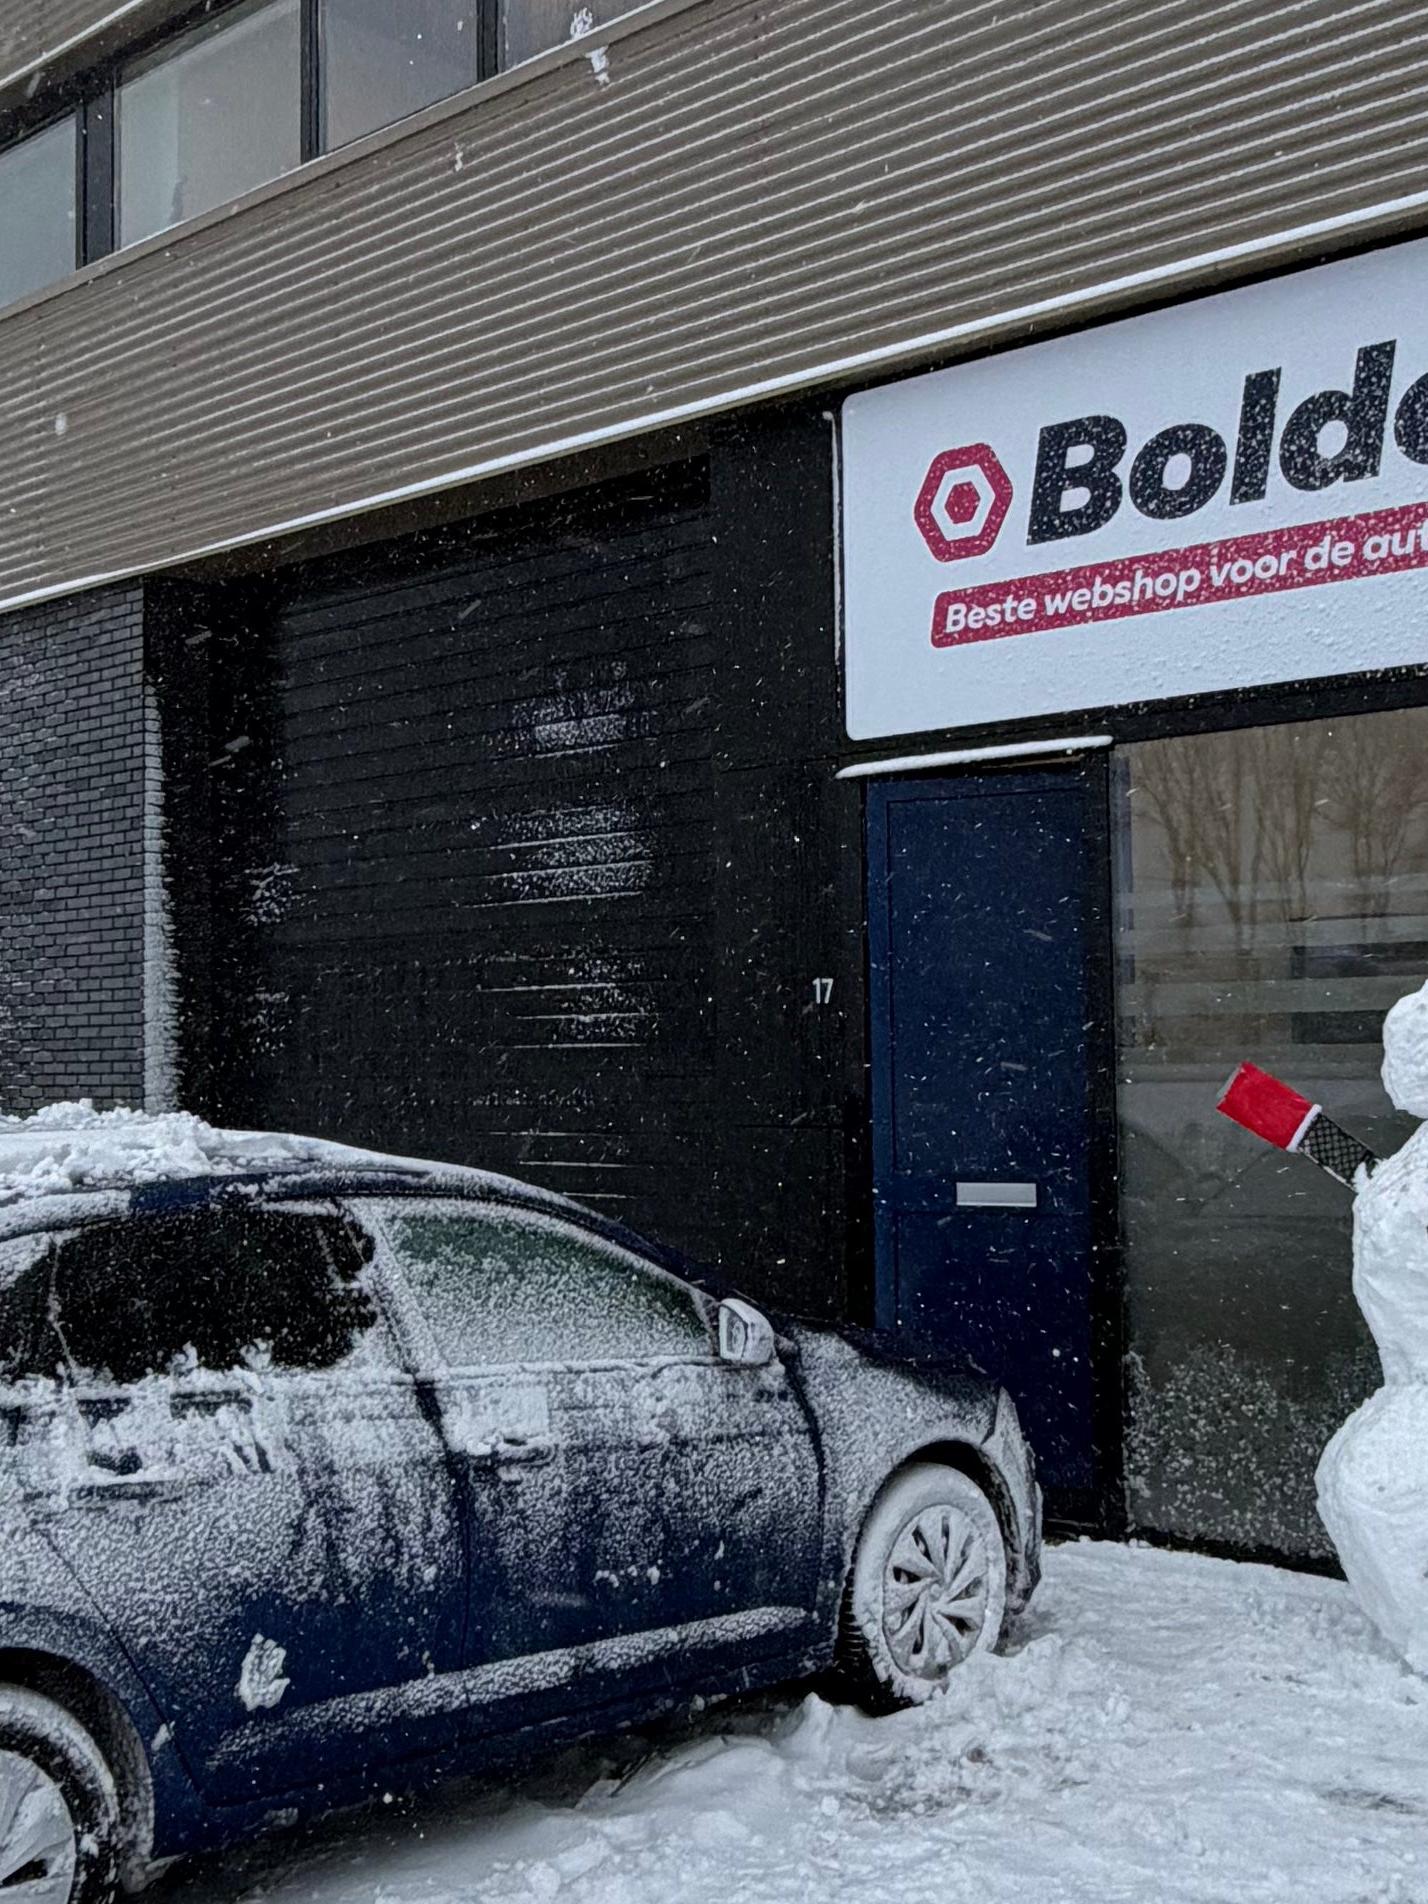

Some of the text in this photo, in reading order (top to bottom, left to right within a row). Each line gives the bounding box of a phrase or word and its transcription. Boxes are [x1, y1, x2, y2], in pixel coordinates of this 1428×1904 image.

[945, 594, 1037, 633] Beste
[1043, 567, 1201, 615] webshop
[1209, 549, 1298, 587] voor
[1303, 534, 1355, 571] de
[812, 977, 834, 1004] 17
